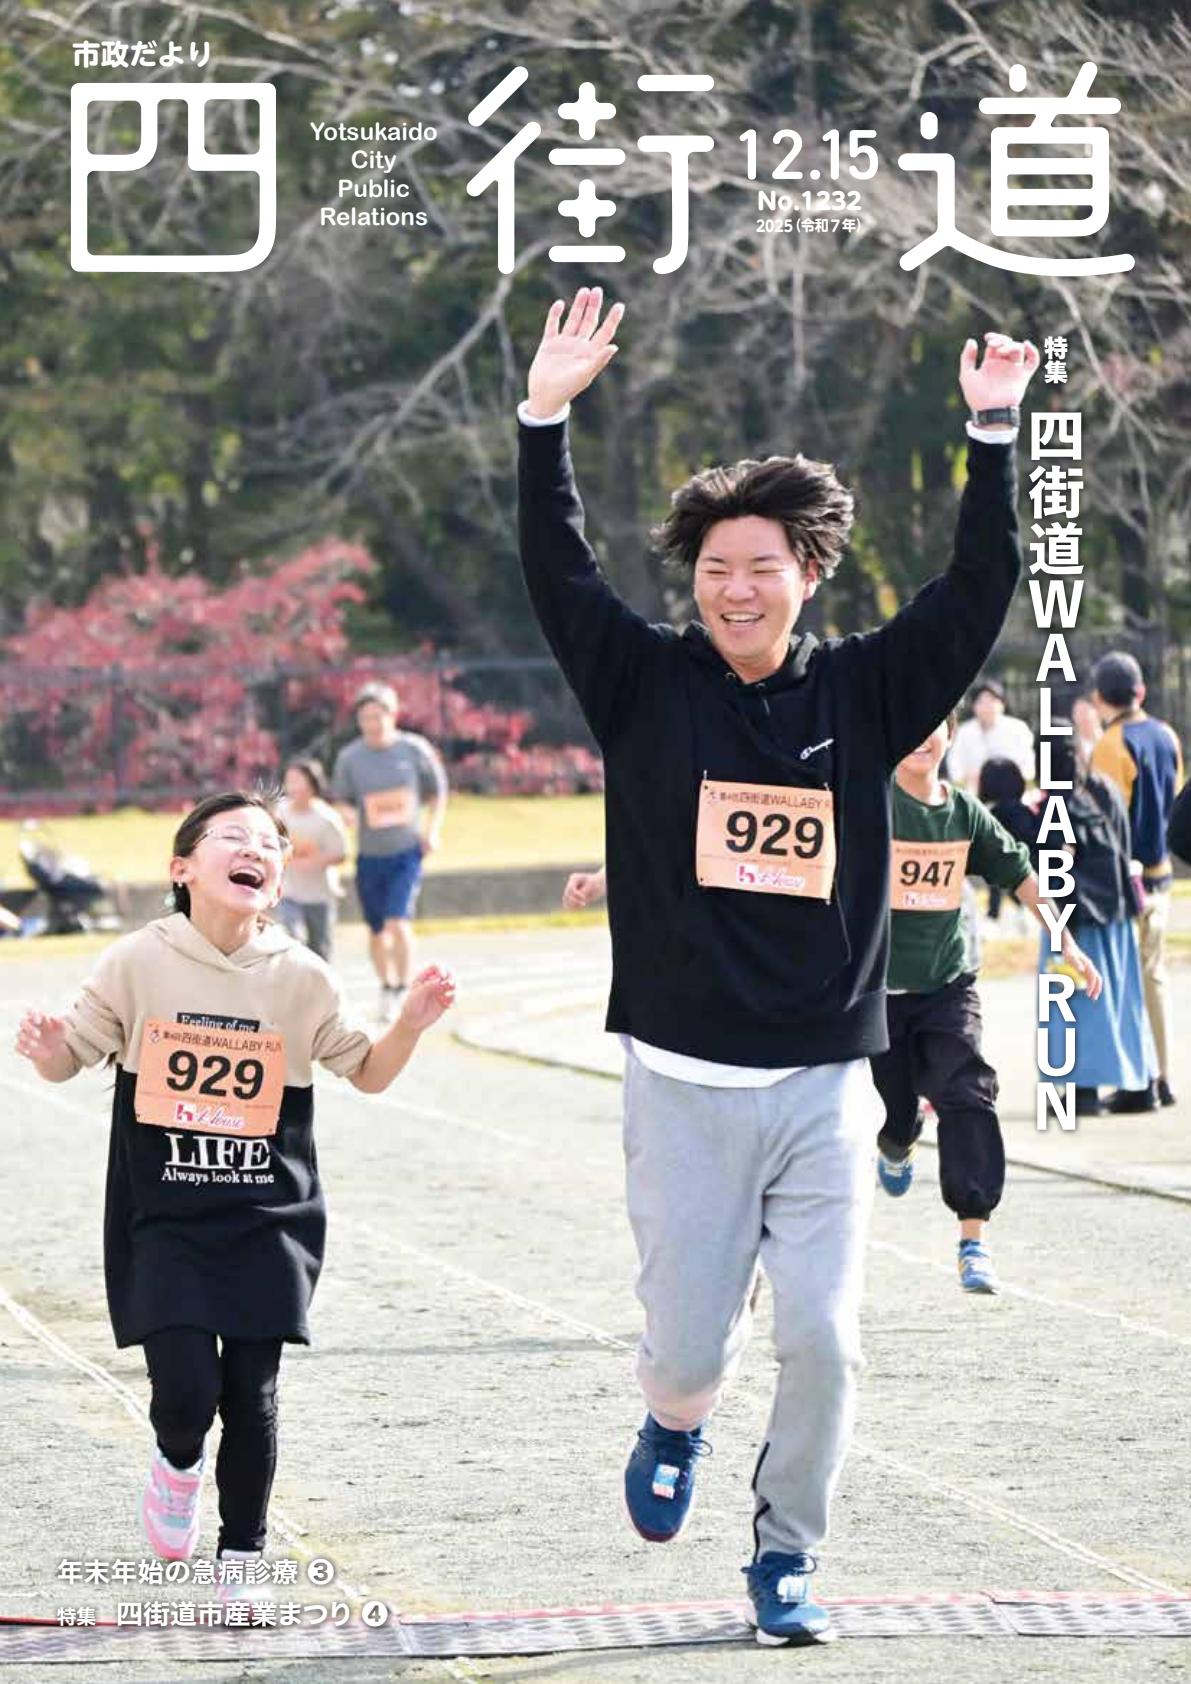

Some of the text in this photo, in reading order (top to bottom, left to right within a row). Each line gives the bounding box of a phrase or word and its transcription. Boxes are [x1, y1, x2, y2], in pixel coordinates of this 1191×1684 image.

[725, 810, 825, 859] 929
[900, 860, 955, 887] 947
[166, 1049, 264, 1100] 929
[164, 1132, 272, 1170] LIFE
[161, 1167, 275, 1186] Always look at me
